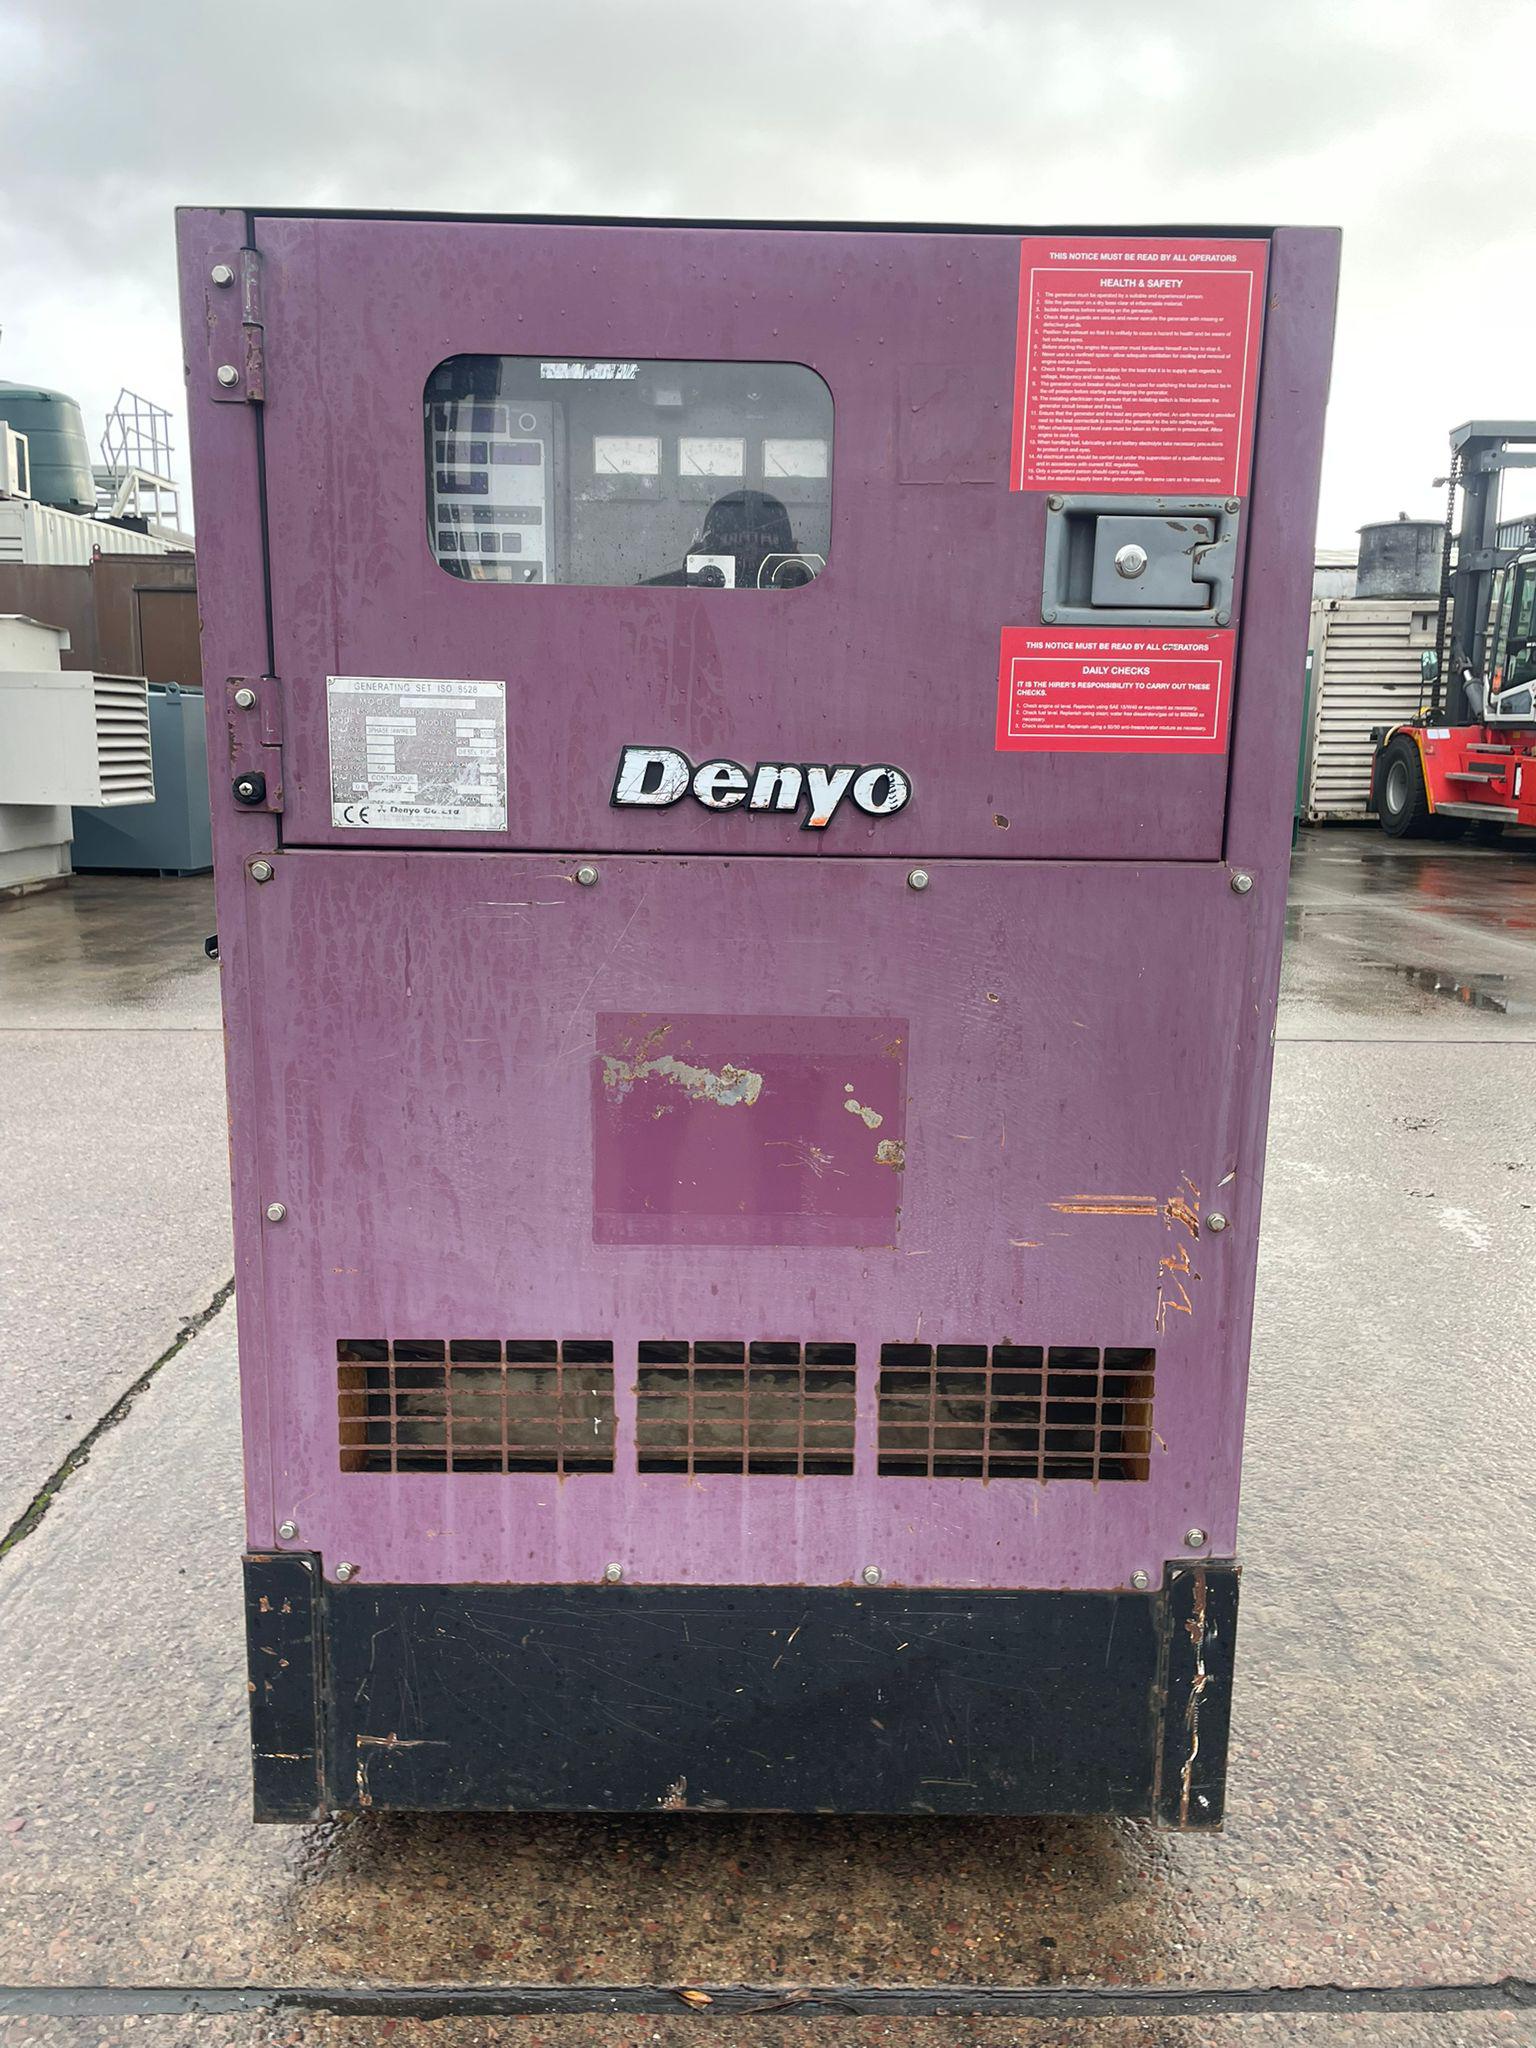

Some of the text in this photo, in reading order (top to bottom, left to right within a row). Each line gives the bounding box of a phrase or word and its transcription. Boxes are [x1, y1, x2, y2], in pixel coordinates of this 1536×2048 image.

[1049, 252, 1067, 260] THIS
[1068, 252, 1098, 260] NOTICE
[1099, 252, 1122, 260] MUST
[1136, 253, 1158, 261] READ
[1159, 253, 1171, 261] BY
[1172, 253, 1187, 261] ALL
[1188, 254, 1237, 262] OPERATORS
[1099, 278, 1183, 287] HEALTH & SAFETY
[1110, 642, 1132, 650] READ
[1082, 666, 1150, 674] DAILY CHECKS
[354, 682, 409, 691] GENERATING
[415, 683, 430, 691] SET
[437, 684, 452, 692] ISO
[611, 745, 911, 829] Denyo
[390, 806, 420, 815] Denyo
